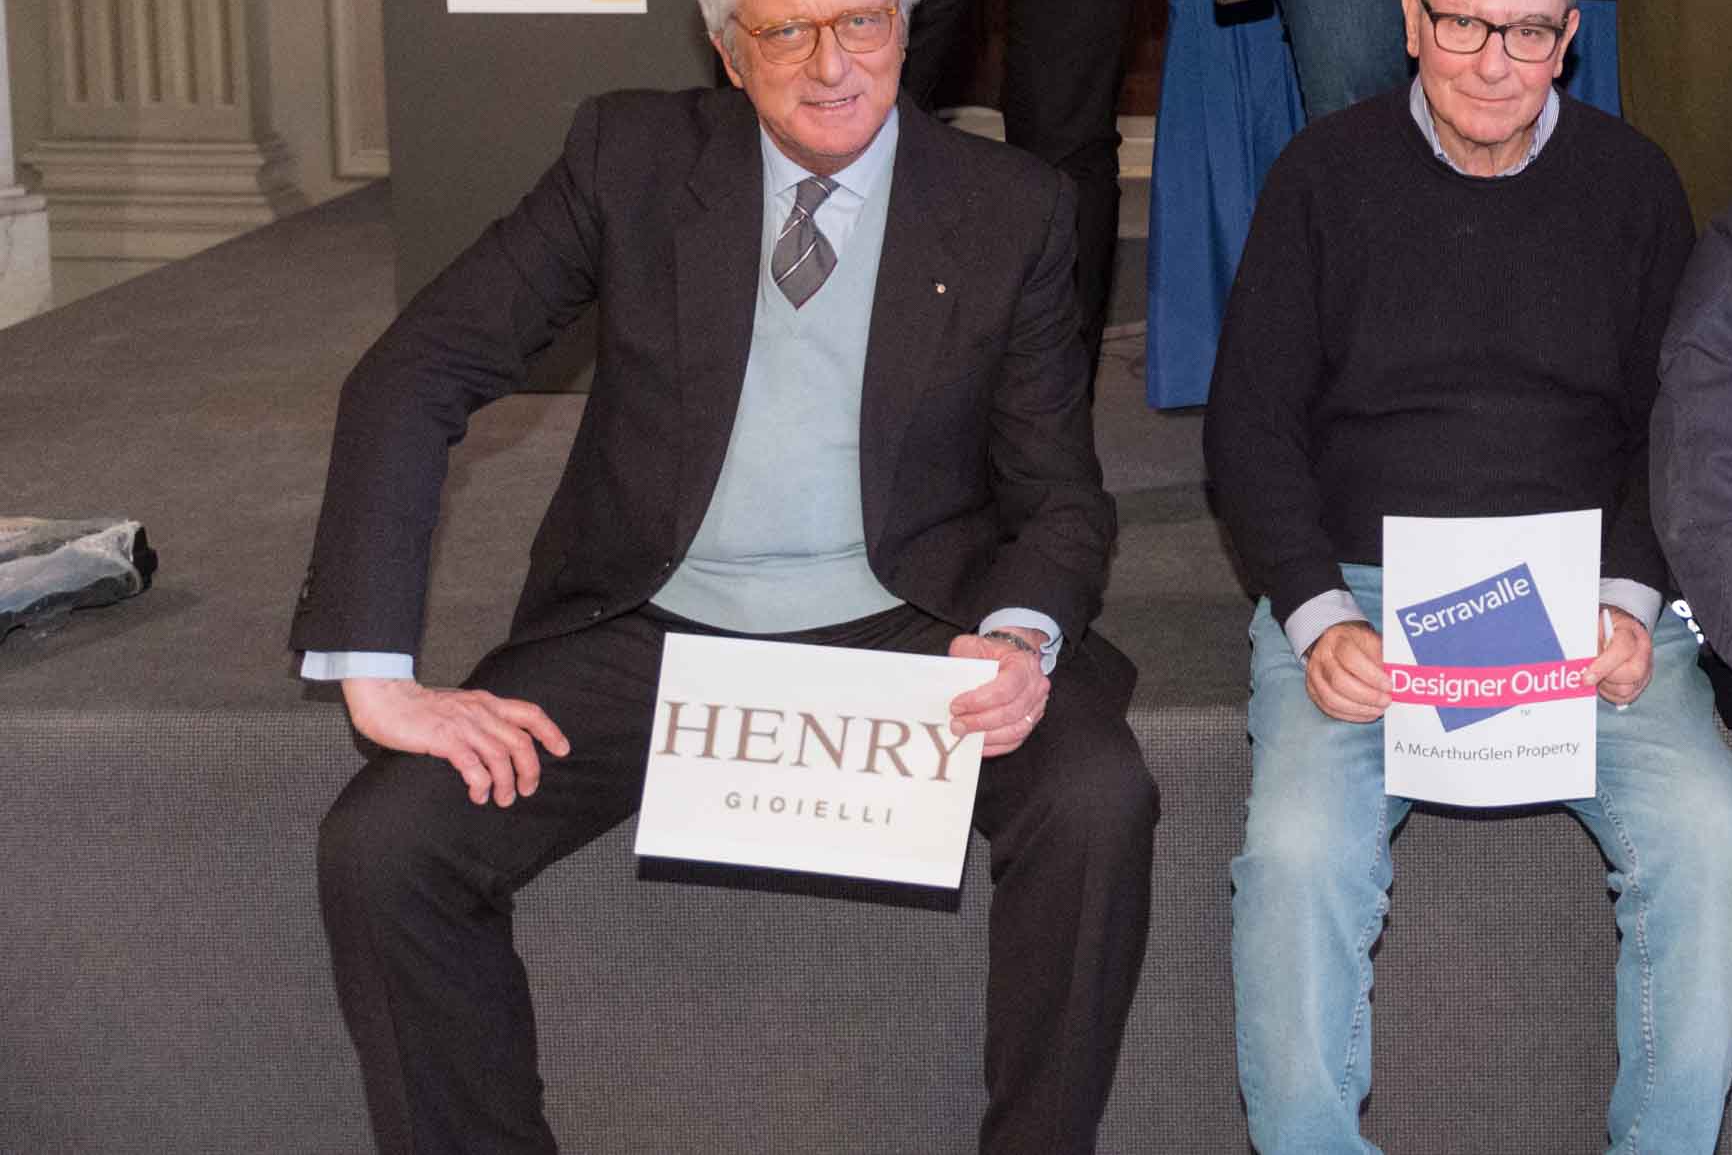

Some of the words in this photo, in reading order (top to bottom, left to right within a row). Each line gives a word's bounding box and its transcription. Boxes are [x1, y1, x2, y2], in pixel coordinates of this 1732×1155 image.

[1404, 577, 1530, 637] Serravalle
[1391, 669, 1506, 702] Designer
[656, 699, 966, 782] HENRY
[1394, 741, 1404, 753] A
[1408, 743, 1512, 761] McArthurGlen
[1517, 740, 1581, 759] Property
[725, 791, 894, 825] GIOIELLI
